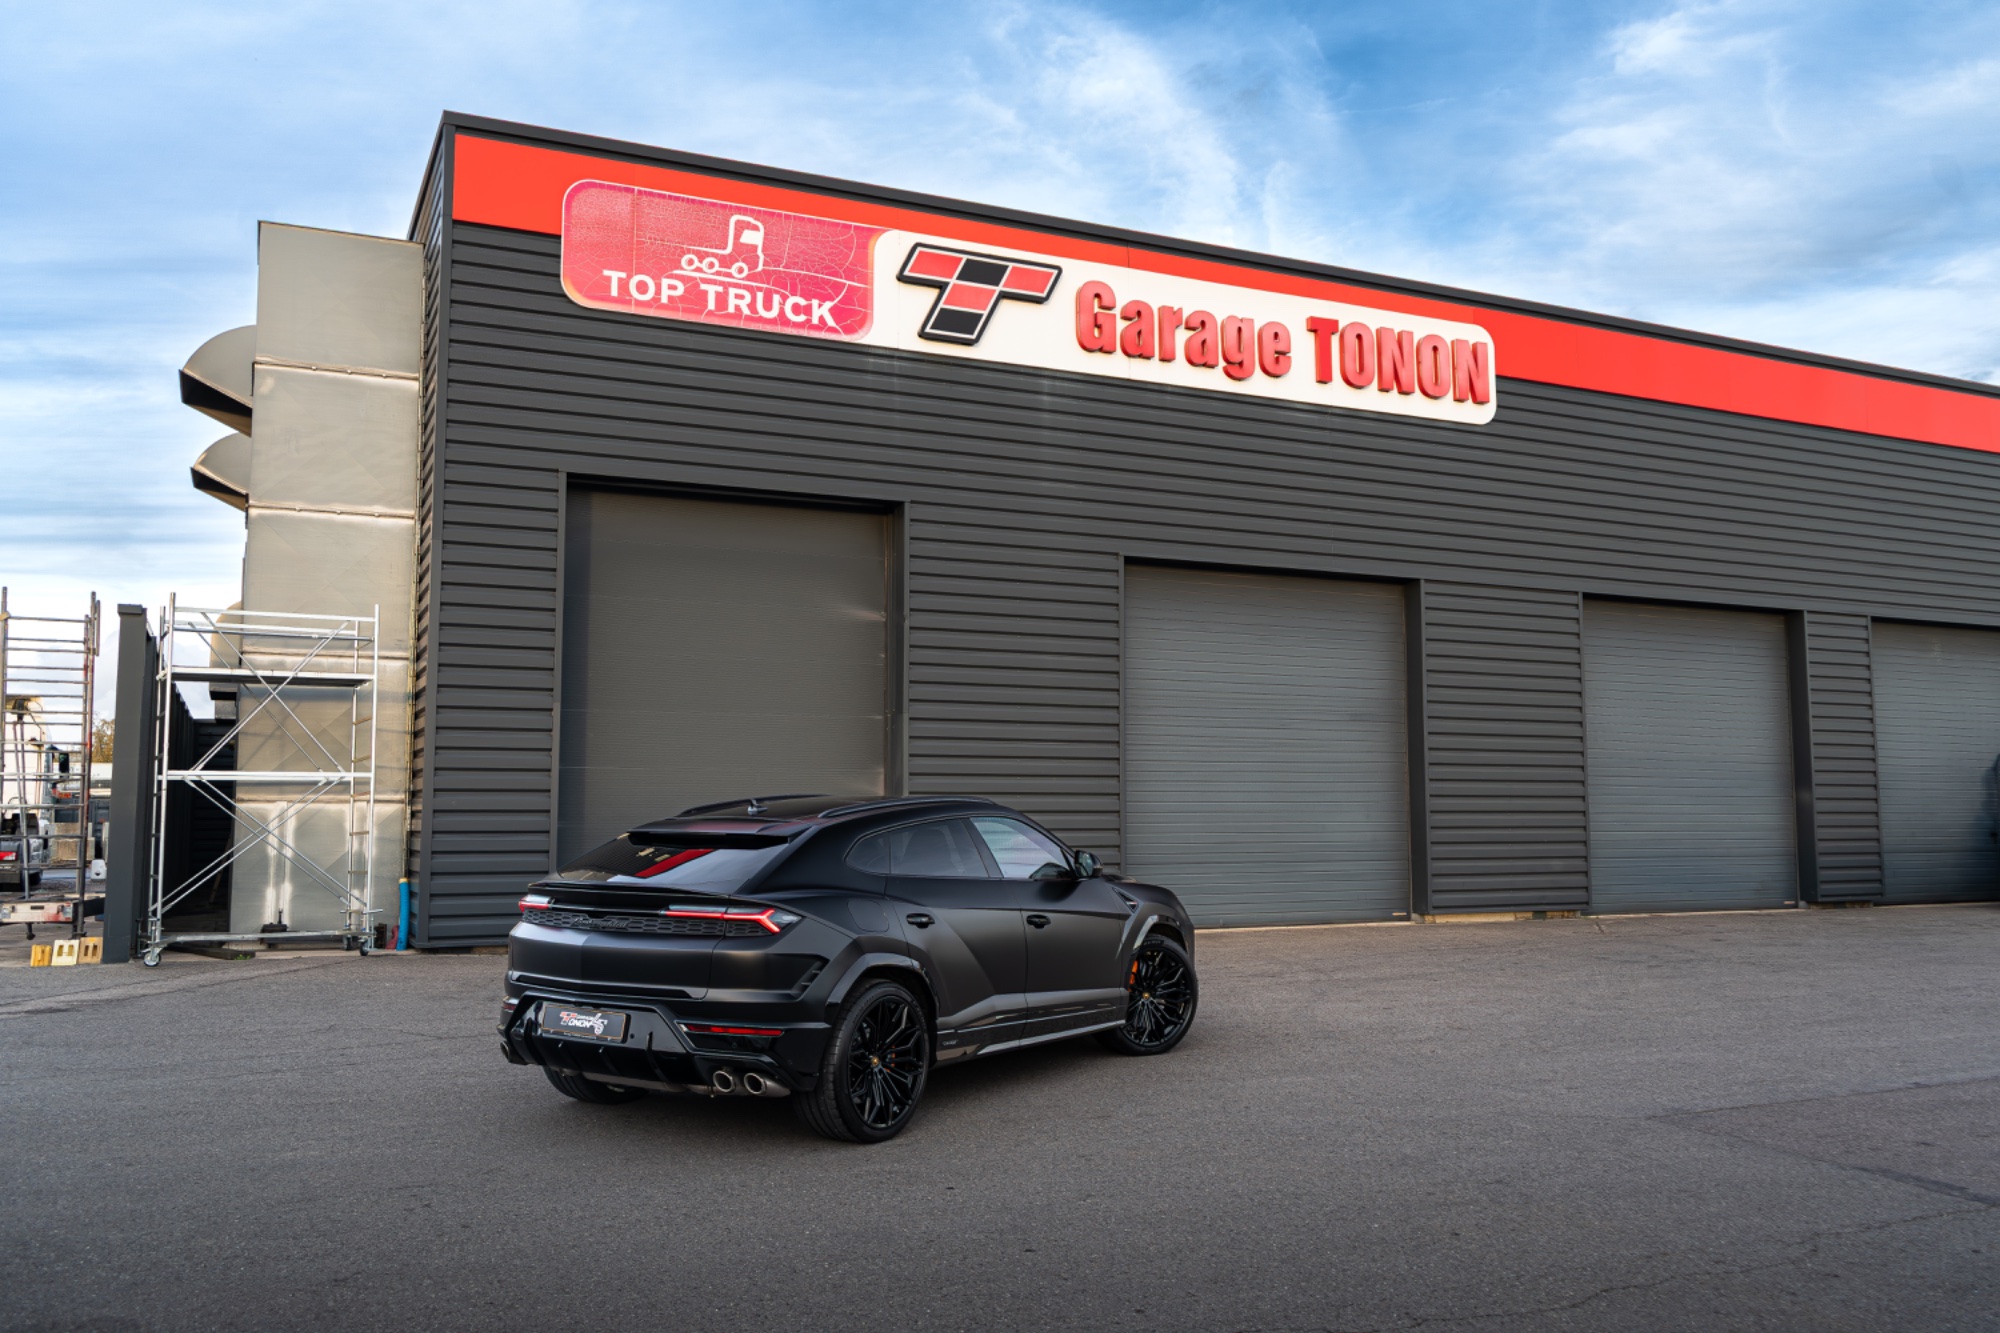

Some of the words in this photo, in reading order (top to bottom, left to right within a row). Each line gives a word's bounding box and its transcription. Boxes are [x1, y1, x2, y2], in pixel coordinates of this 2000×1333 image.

[602, 269, 685, 304] TOP
[700, 283, 837, 327] TRUCK
[1075, 280, 1292, 381] Garage
[1306, 316, 1490, 405] TONON
